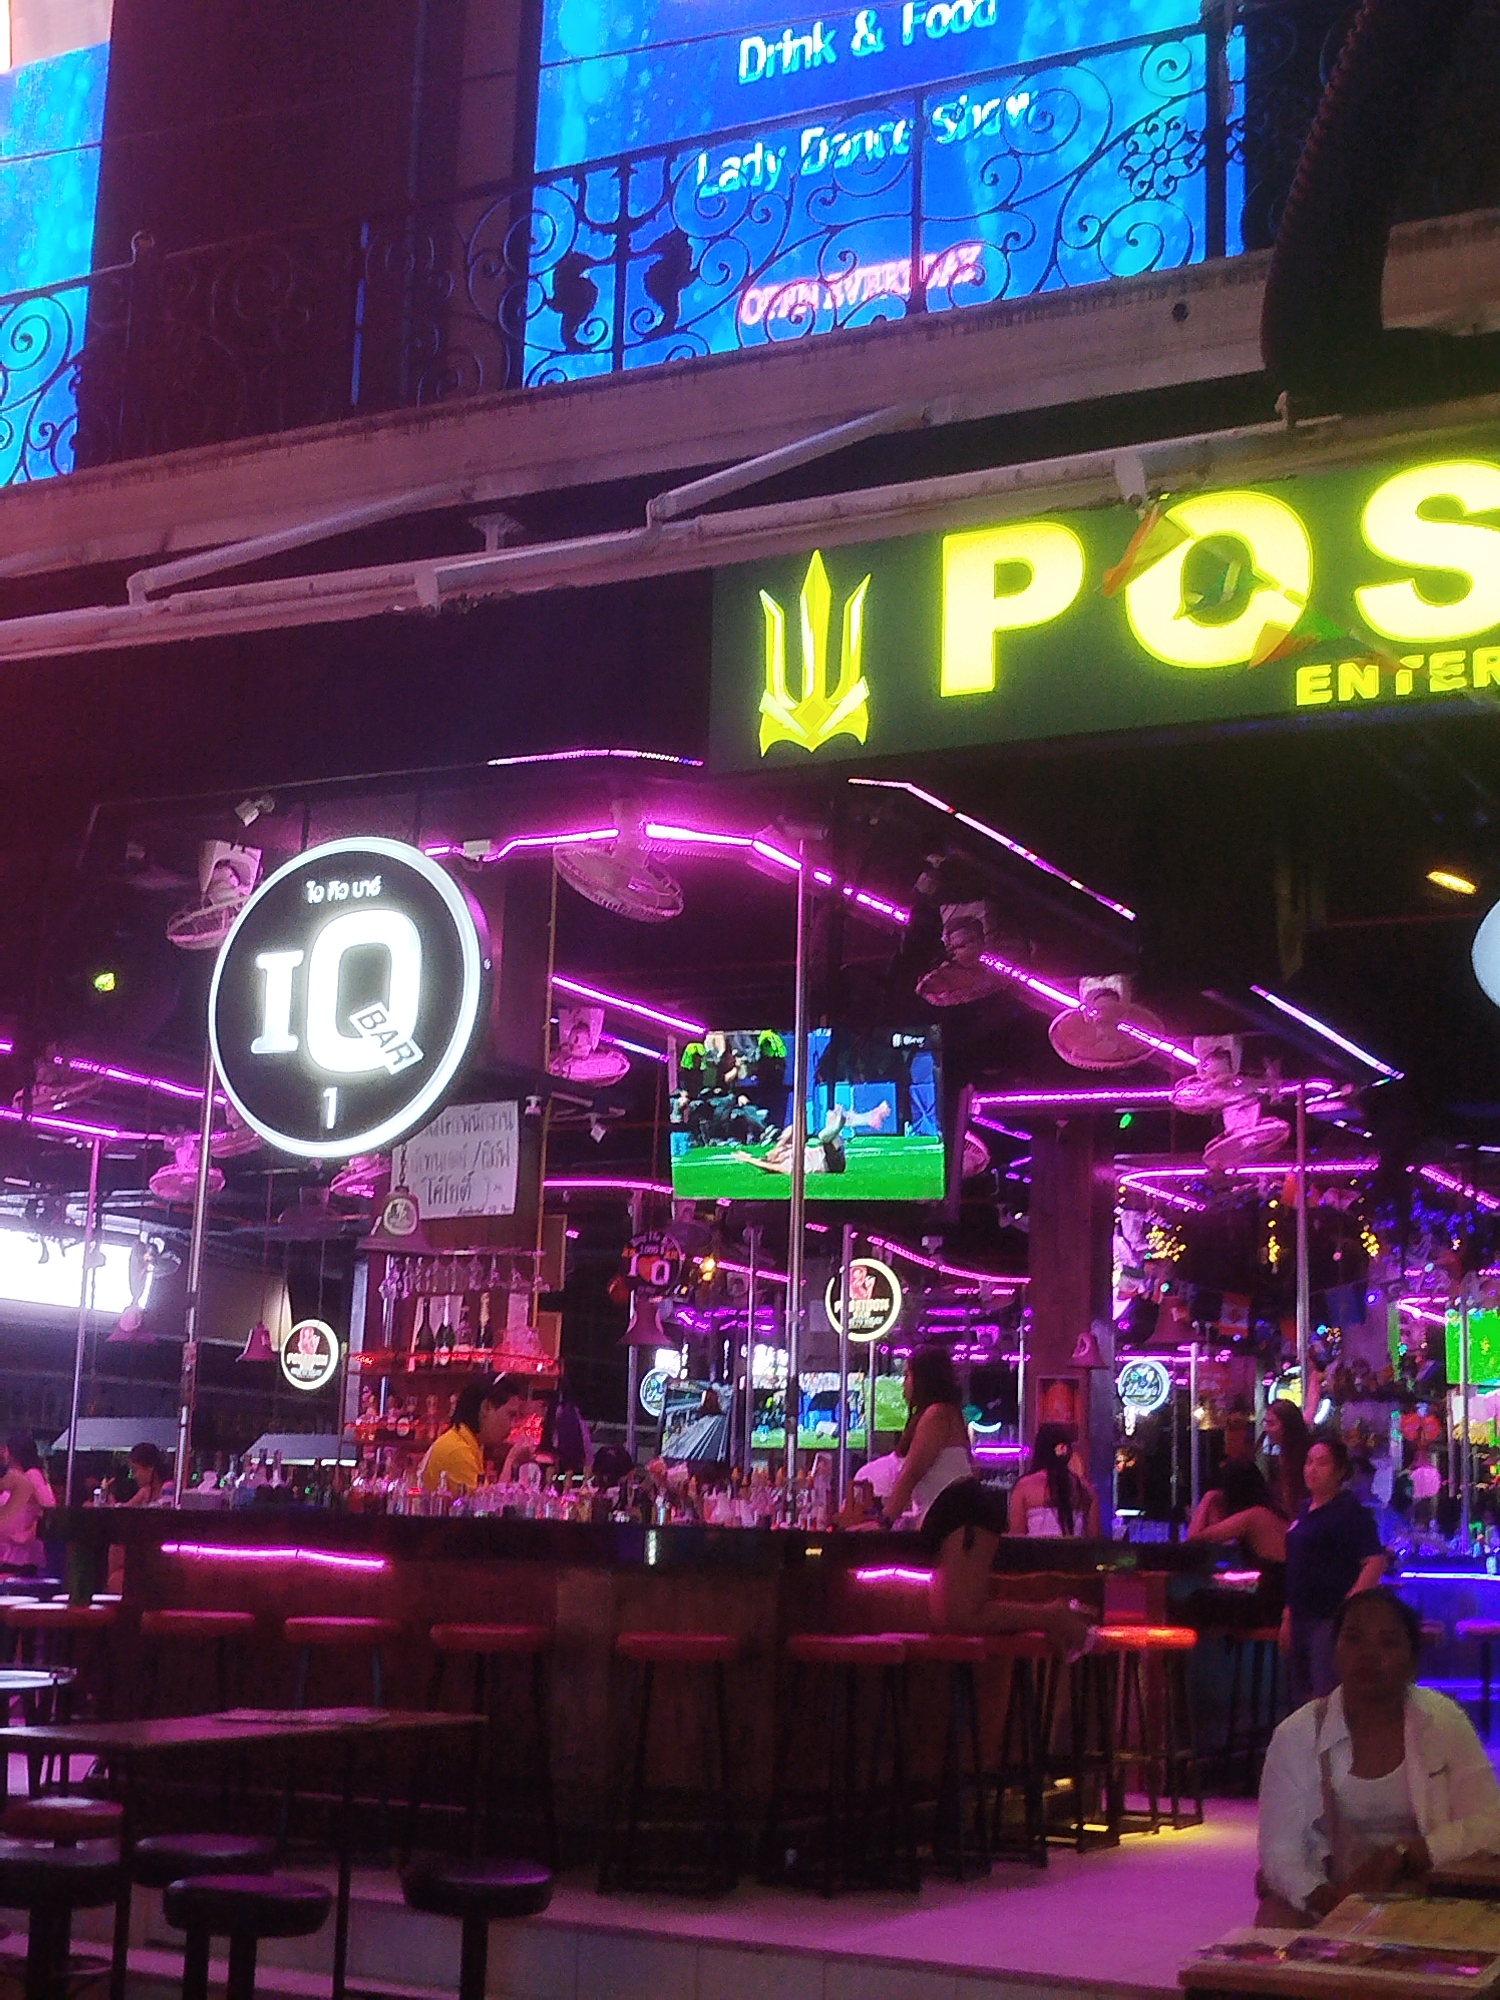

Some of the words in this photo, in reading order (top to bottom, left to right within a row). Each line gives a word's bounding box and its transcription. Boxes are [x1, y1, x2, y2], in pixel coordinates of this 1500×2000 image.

[738, 20, 838, 85] Drink
[850, 8, 886, 57] &
[902, 0, 998, 46] Food
[696, 140, 789, 200] Lady
[800, 117, 917, 176] Dance
[930, 91, 1041, 145] Show
[940, 460, 1500, 698] POS
[1295, 646, 1500, 706] ENTER
[250, 908, 422, 1074] IQ
[354, 1007, 418, 1069] BAR
[322, 1086, 339, 1130] 1
